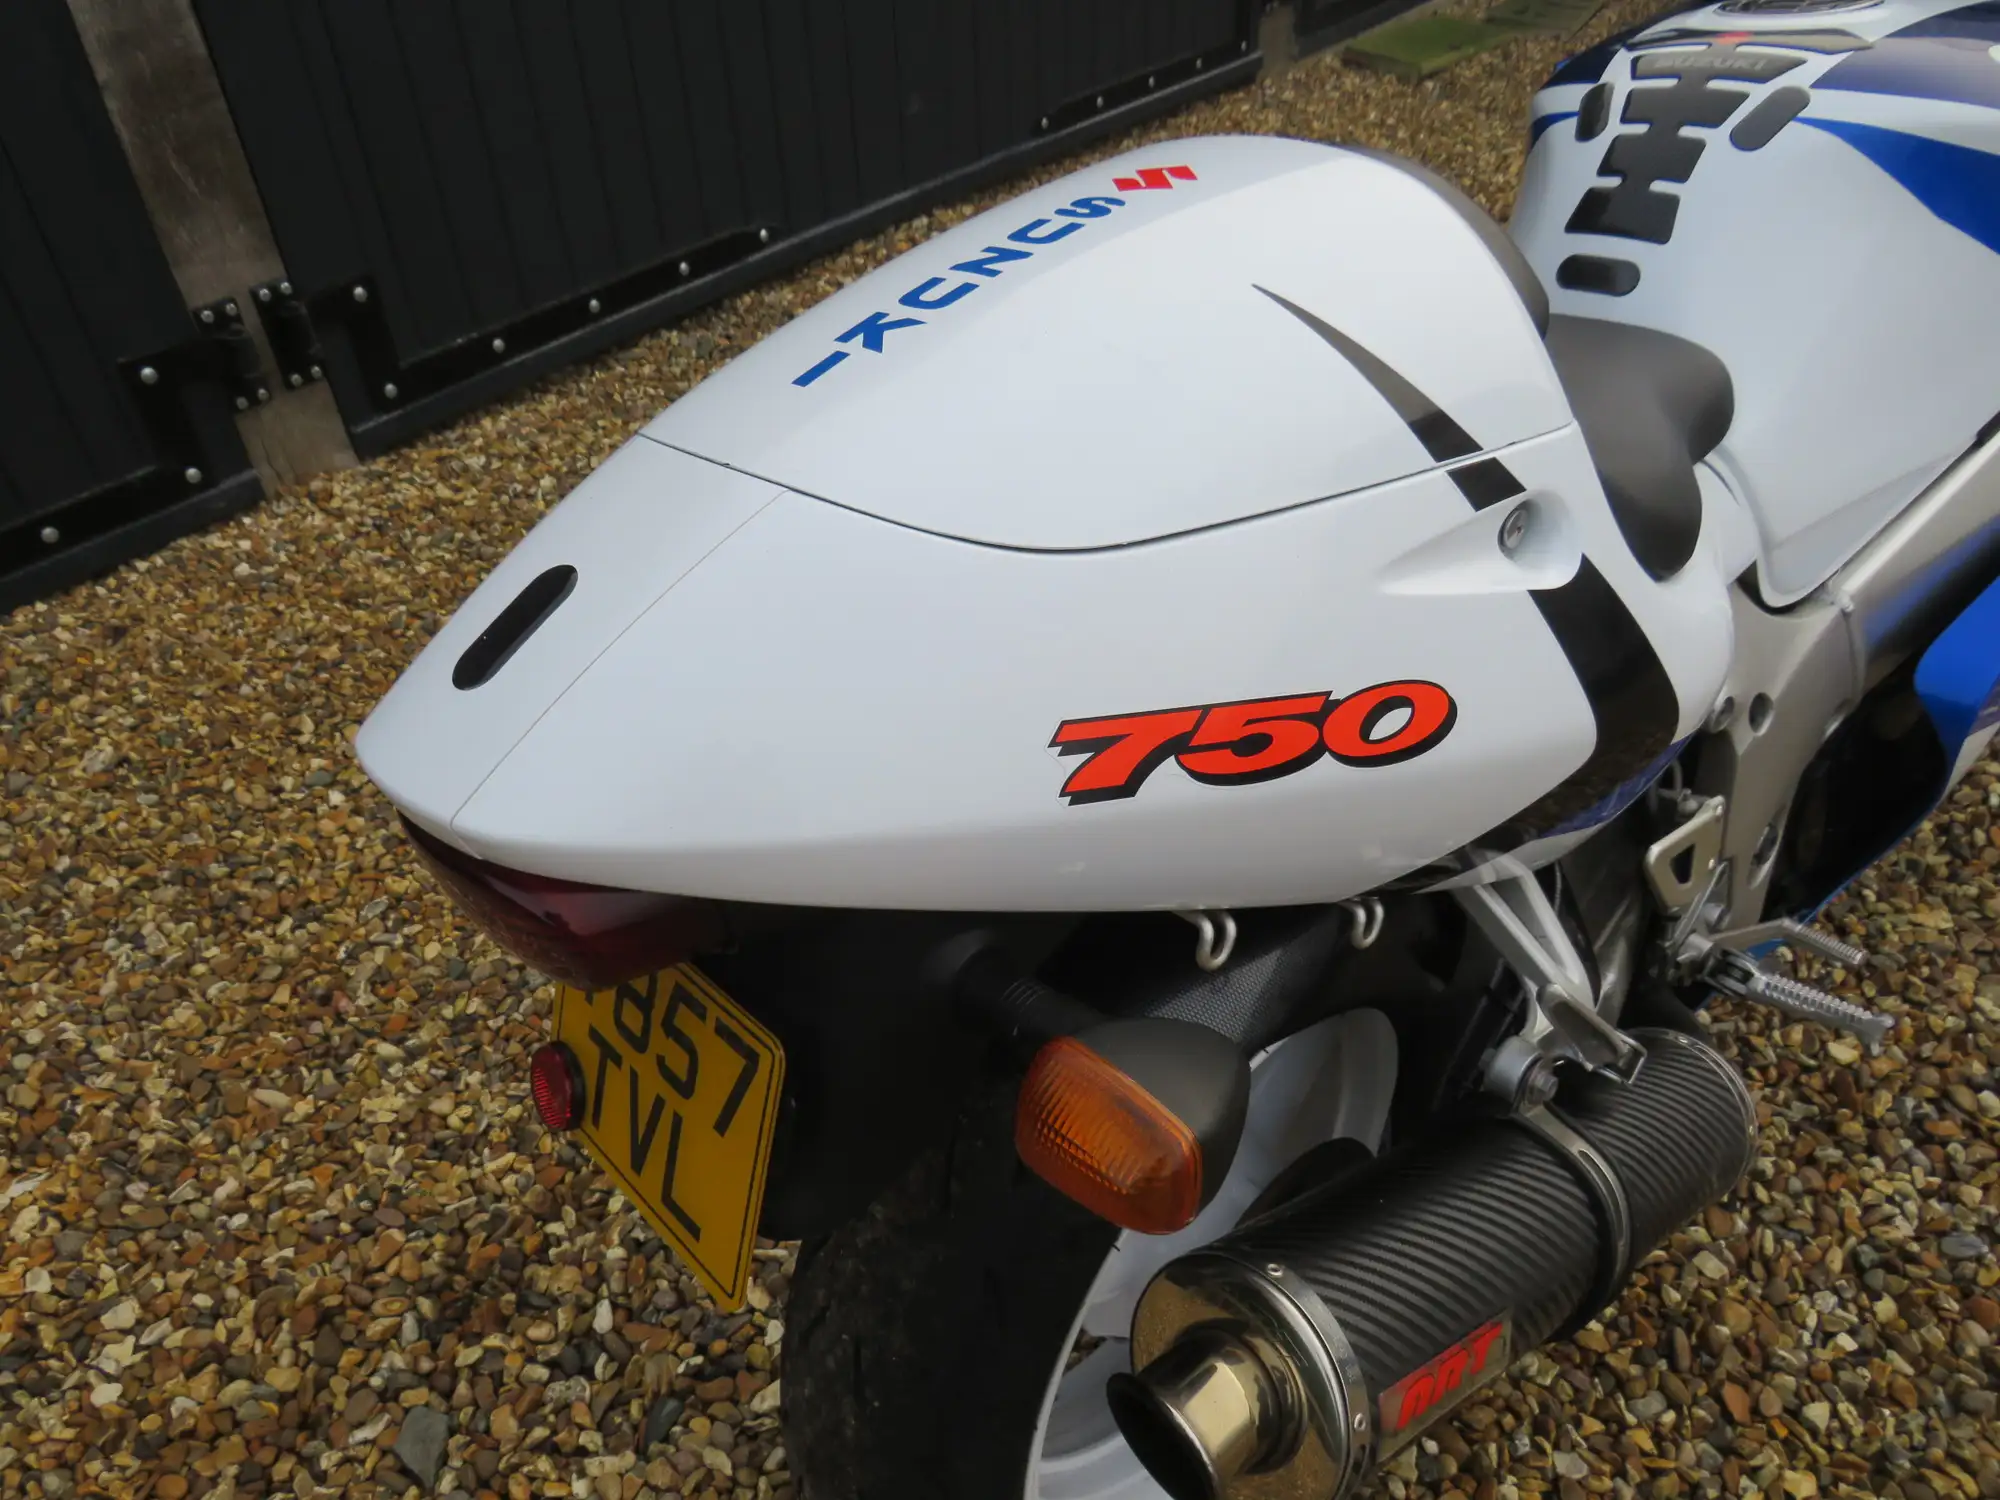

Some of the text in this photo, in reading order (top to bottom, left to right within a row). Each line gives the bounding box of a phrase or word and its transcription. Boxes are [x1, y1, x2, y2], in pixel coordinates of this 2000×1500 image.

[1655, 55, 1768, 71] SUZUKI
[793, 197, 1126, 388] SUZUKI
[1048, 679, 1459, 807] 750
[583, 970, 761, 1138] 857
[588, 1026, 701, 1243] TVL
